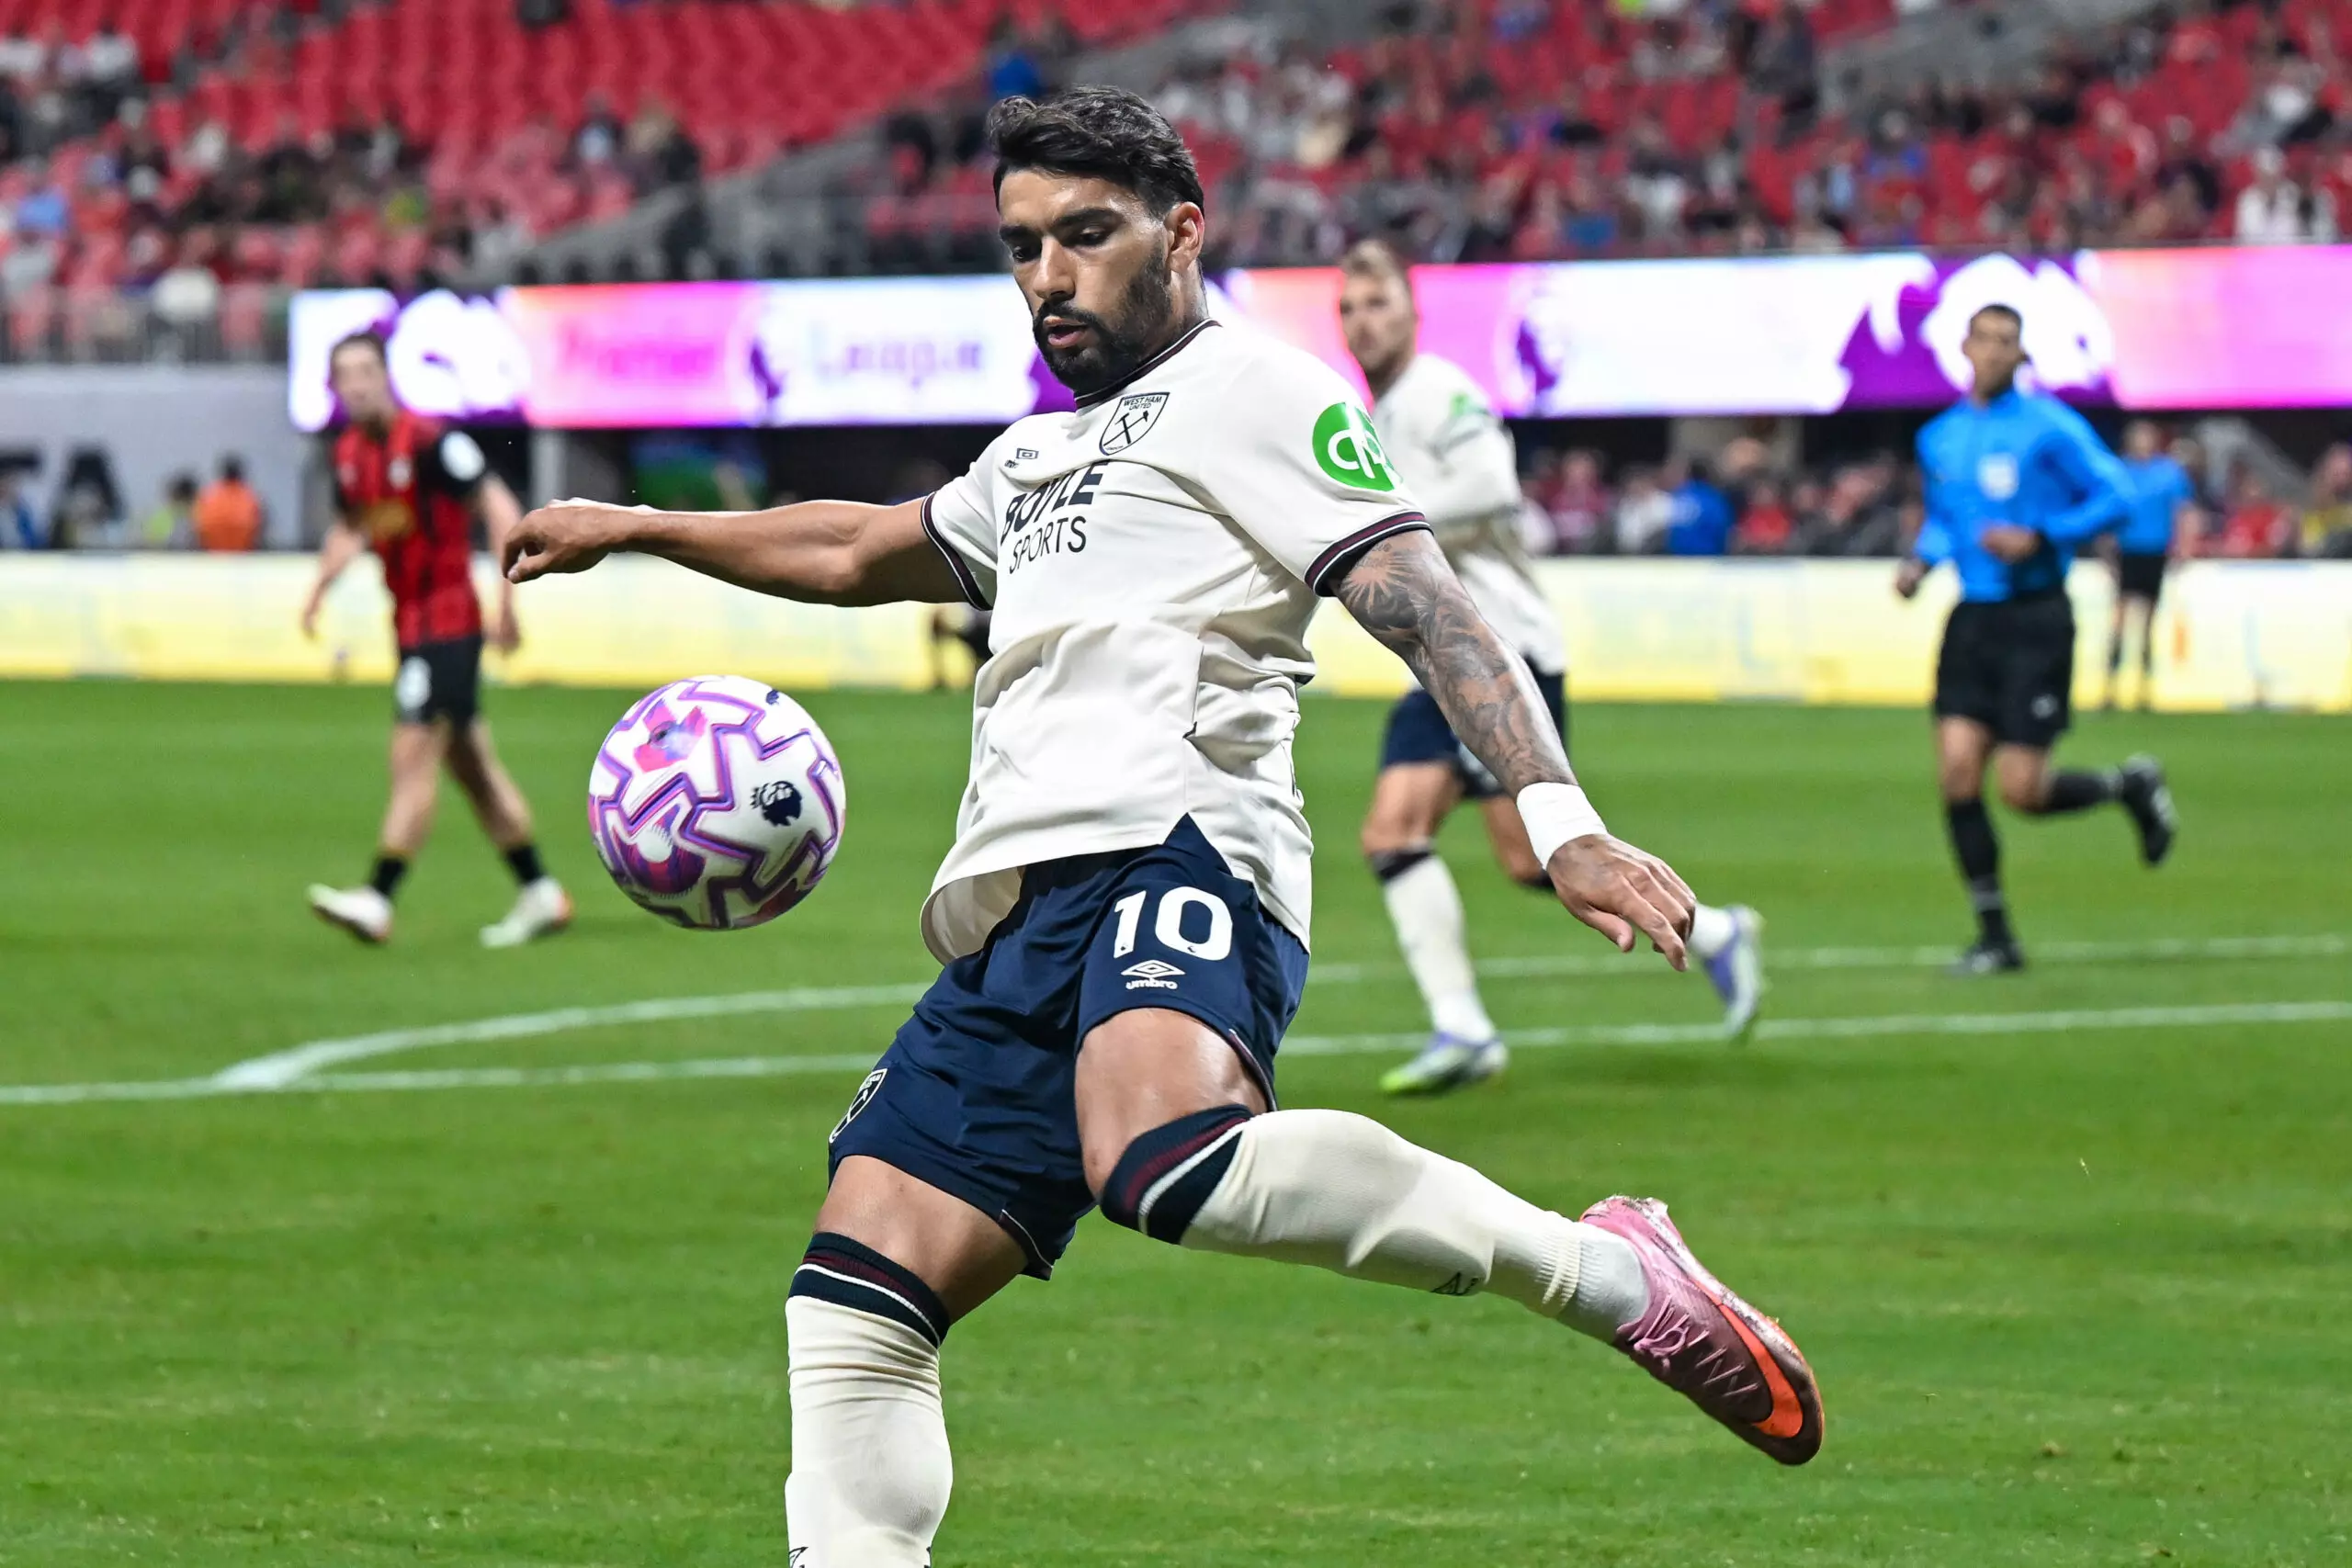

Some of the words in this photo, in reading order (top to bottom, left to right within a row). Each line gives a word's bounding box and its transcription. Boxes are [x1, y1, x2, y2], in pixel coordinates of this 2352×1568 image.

[1124, 396, 1145, 406] WEST
[1001, 462, 1108, 546] BOYLE
[1010, 516, 1086, 574] SPORTS
[1114, 886, 1233, 961] 10
[1125, 978, 1178, 989] umbro
